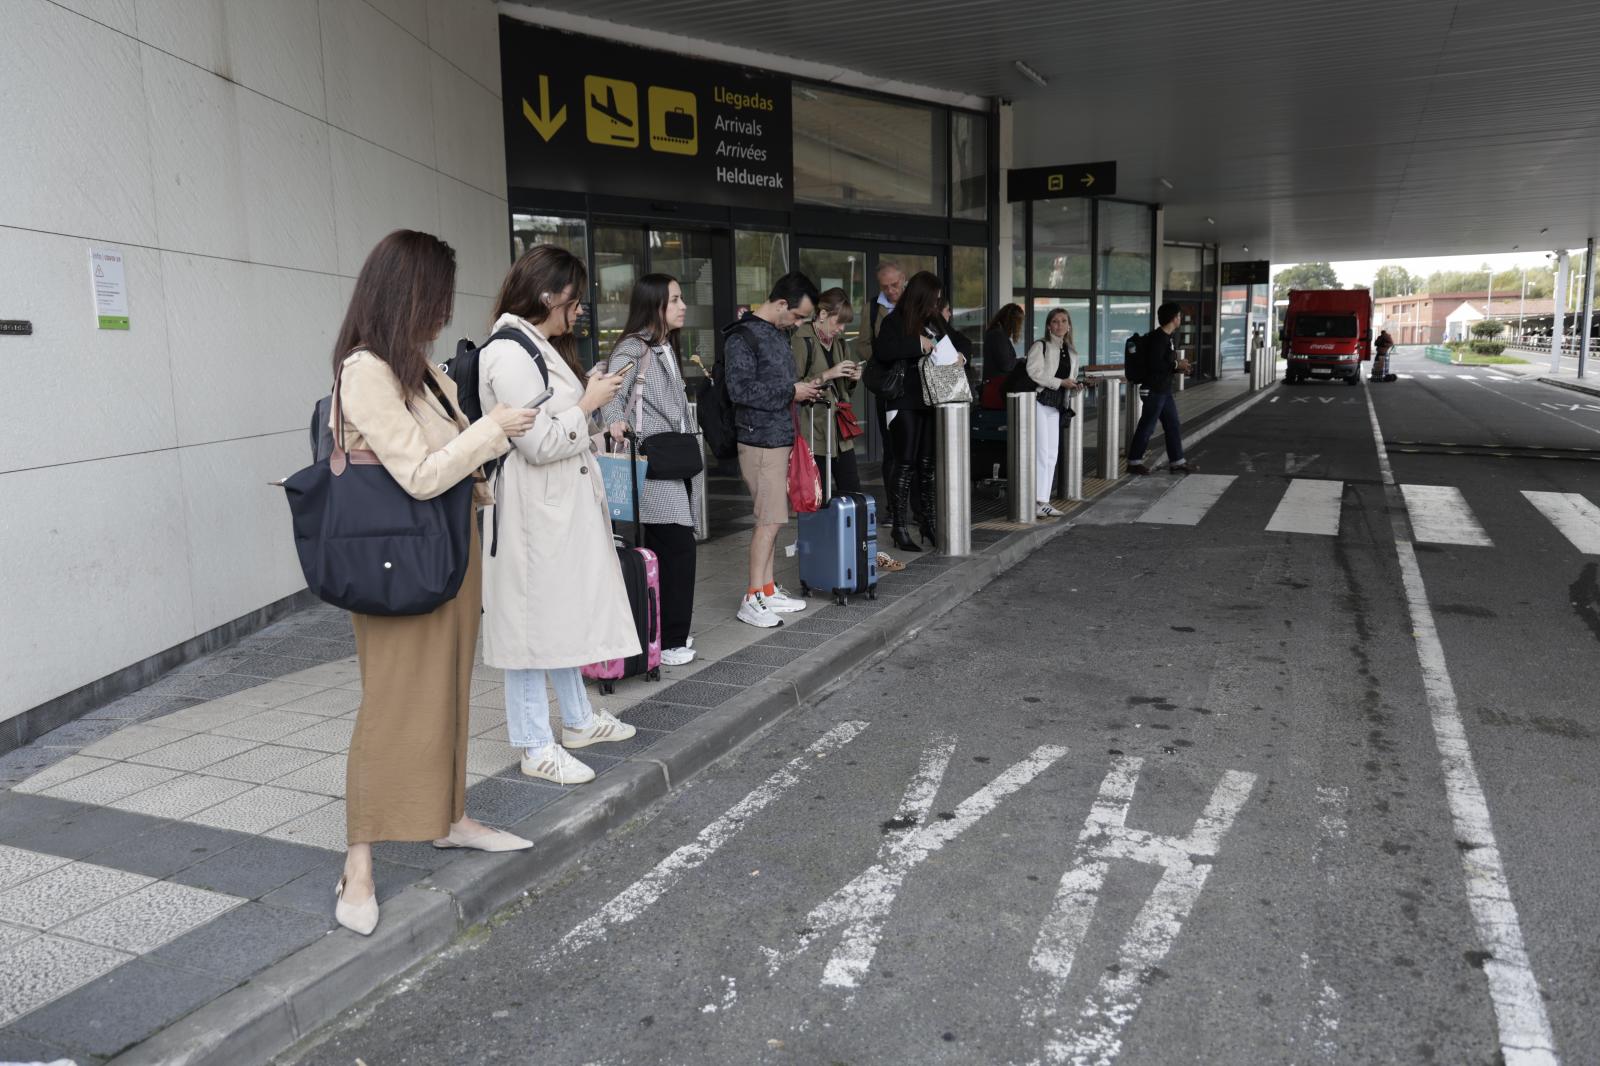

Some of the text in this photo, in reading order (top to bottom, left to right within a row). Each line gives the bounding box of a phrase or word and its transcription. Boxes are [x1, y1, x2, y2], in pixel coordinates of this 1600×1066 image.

[713, 86, 773, 111] Llegadas
[714, 114, 763, 137] Arrivals
[715, 140, 767, 161] Arrivées
[716, 166, 784, 189] Helduerak
